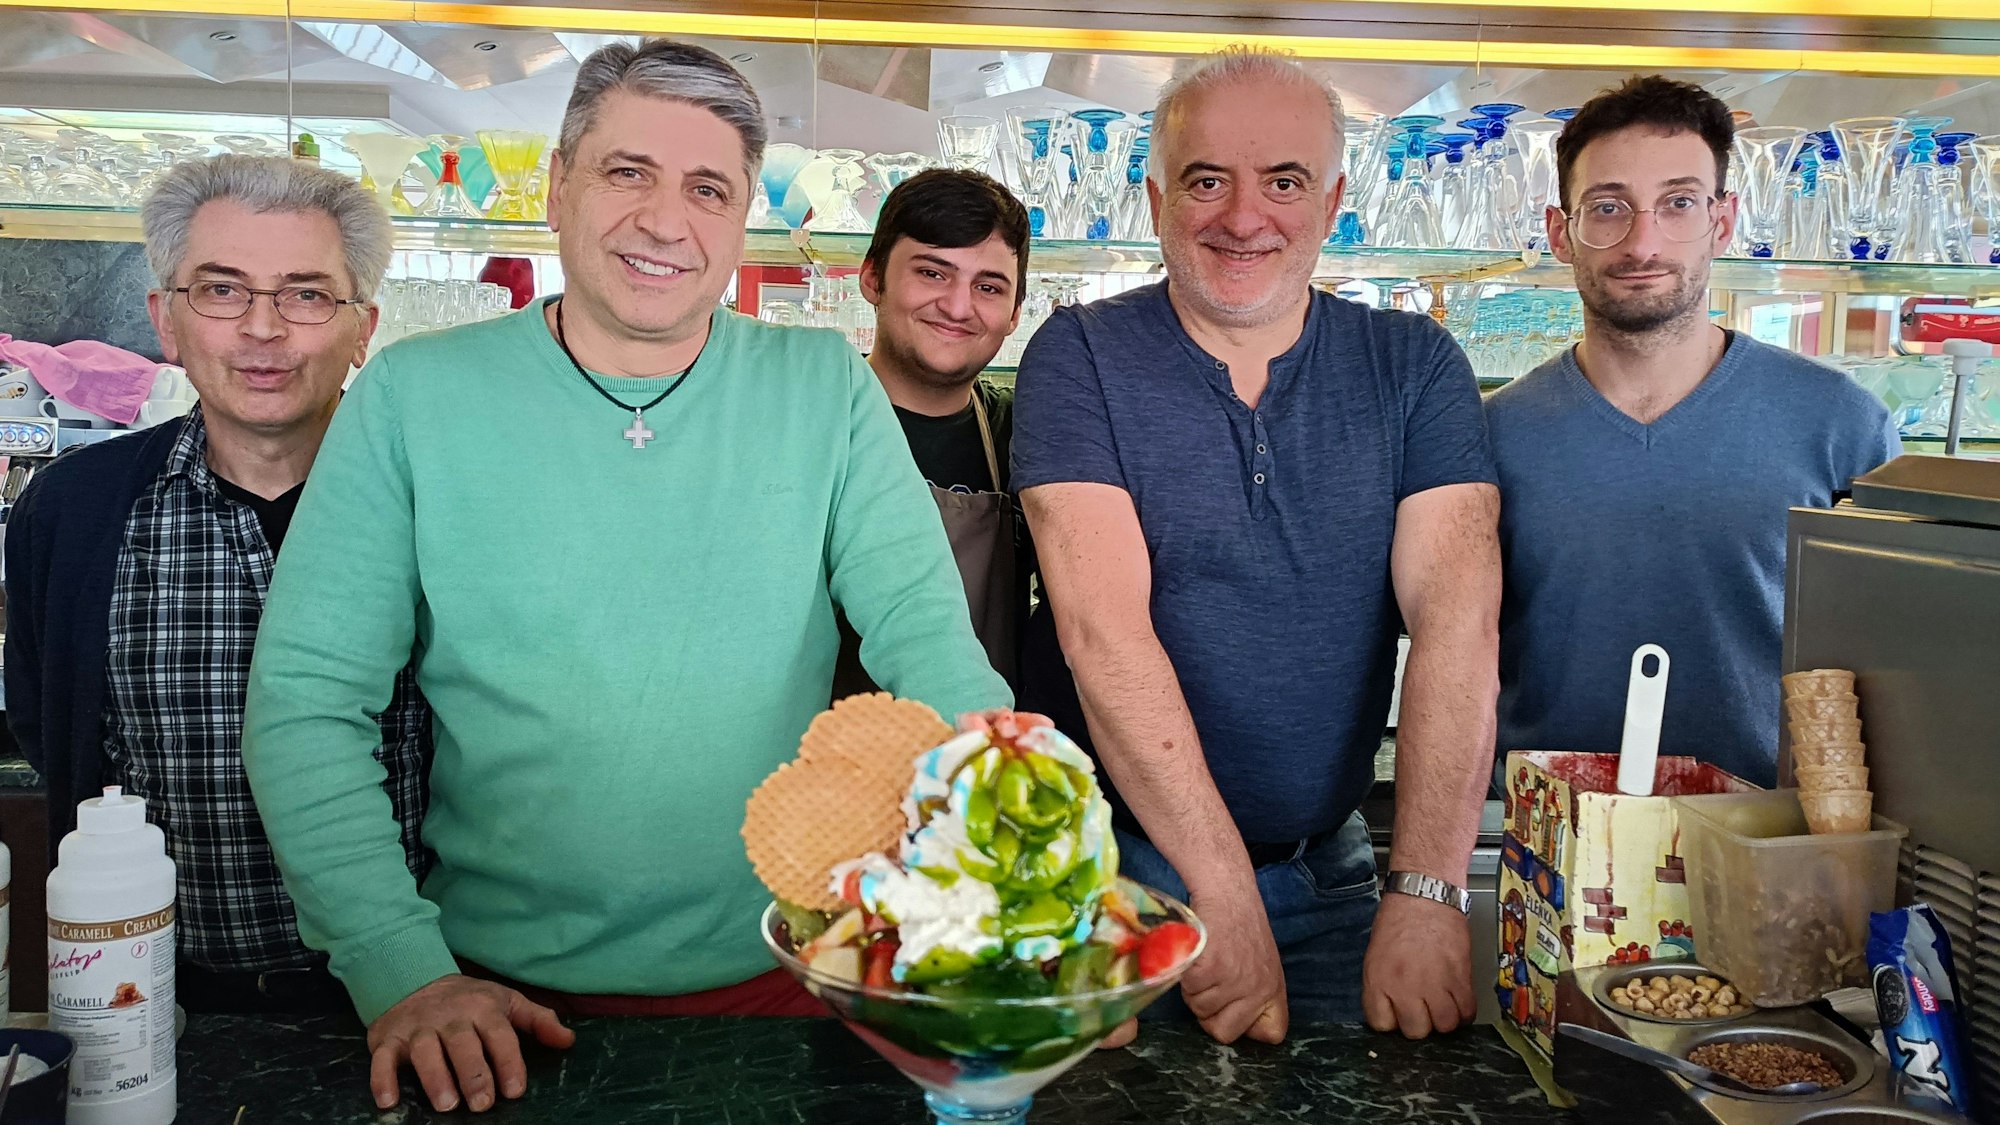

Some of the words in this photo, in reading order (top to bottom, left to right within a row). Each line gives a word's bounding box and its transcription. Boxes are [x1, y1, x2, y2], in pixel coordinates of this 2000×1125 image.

[61, 924, 114, 939] CARAMELL
[124, 918, 158, 935] CREAM
[56, 992, 104, 1008] CARAMELL
[115, 1073, 149, 1092] 56204
